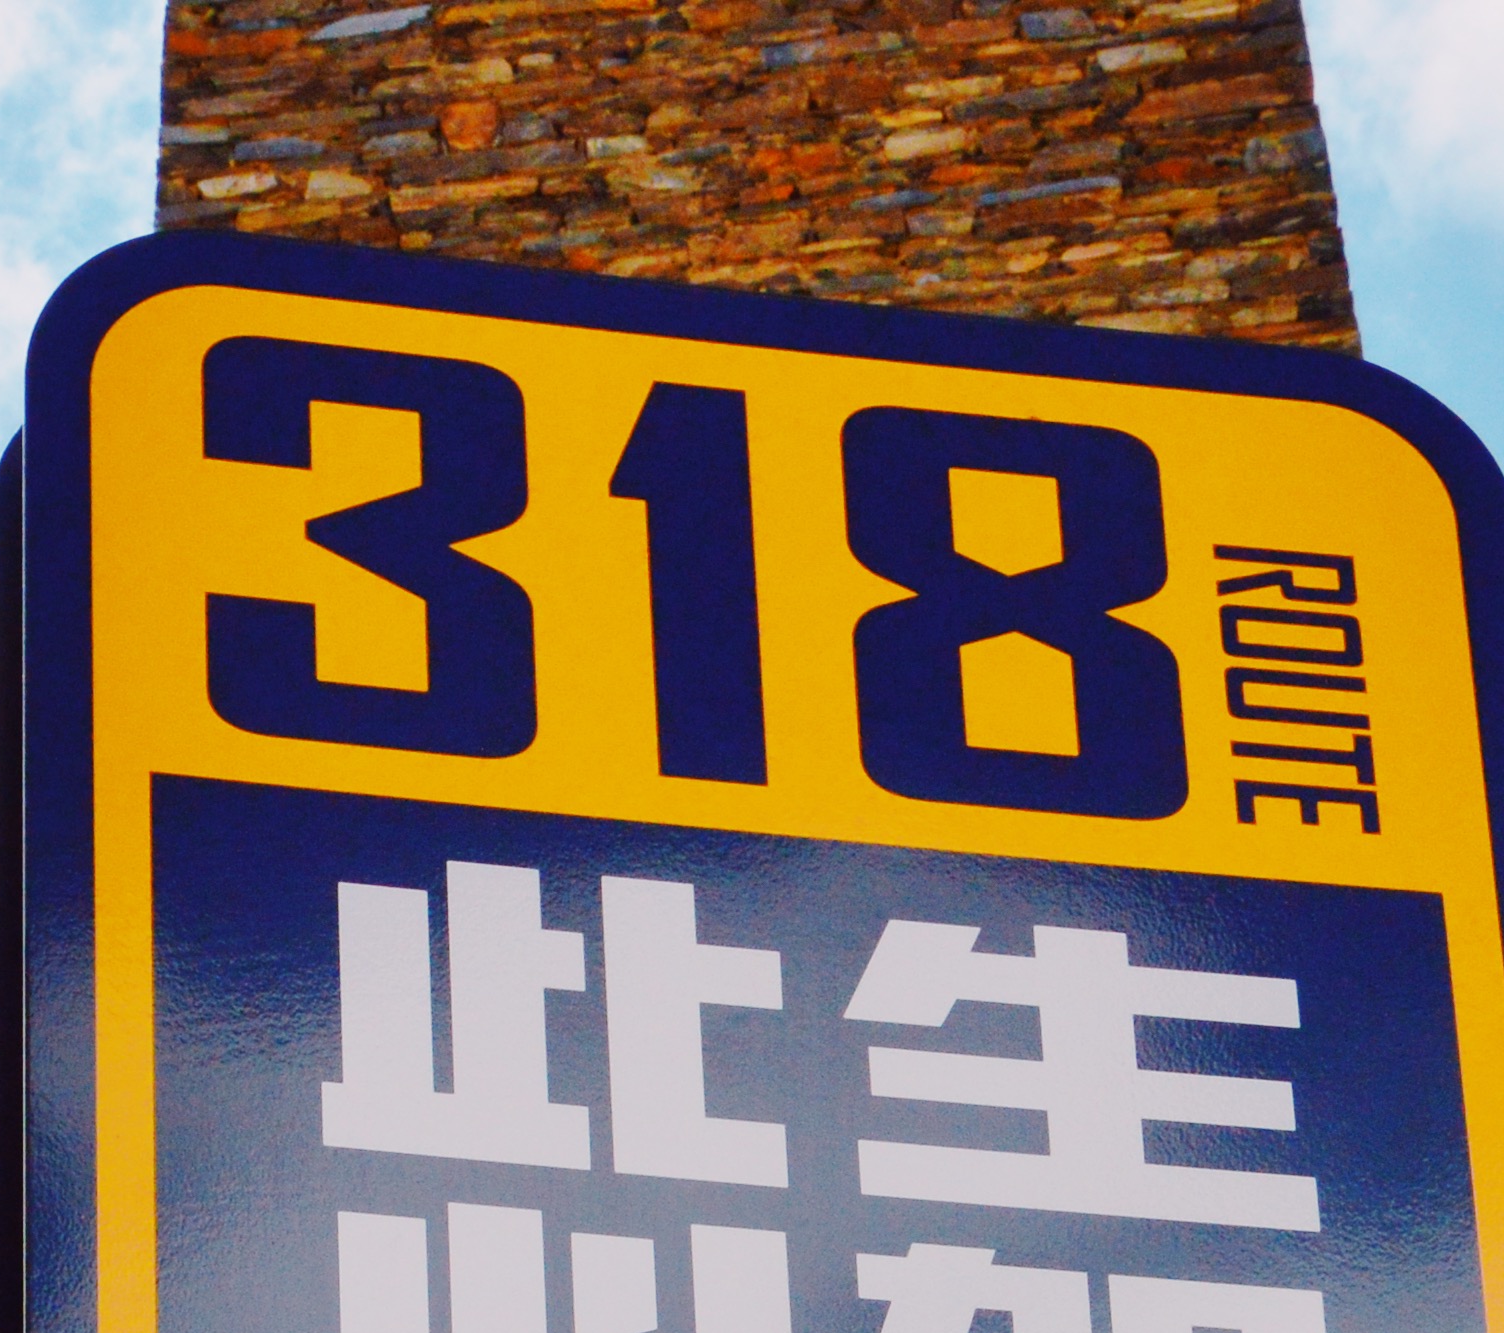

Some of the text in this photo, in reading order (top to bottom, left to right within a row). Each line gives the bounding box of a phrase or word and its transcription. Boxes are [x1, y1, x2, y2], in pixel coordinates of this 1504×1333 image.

[203, 336, 1379, 833] 318 ROUTE
[322, 861, 1320, 1231] 此生
